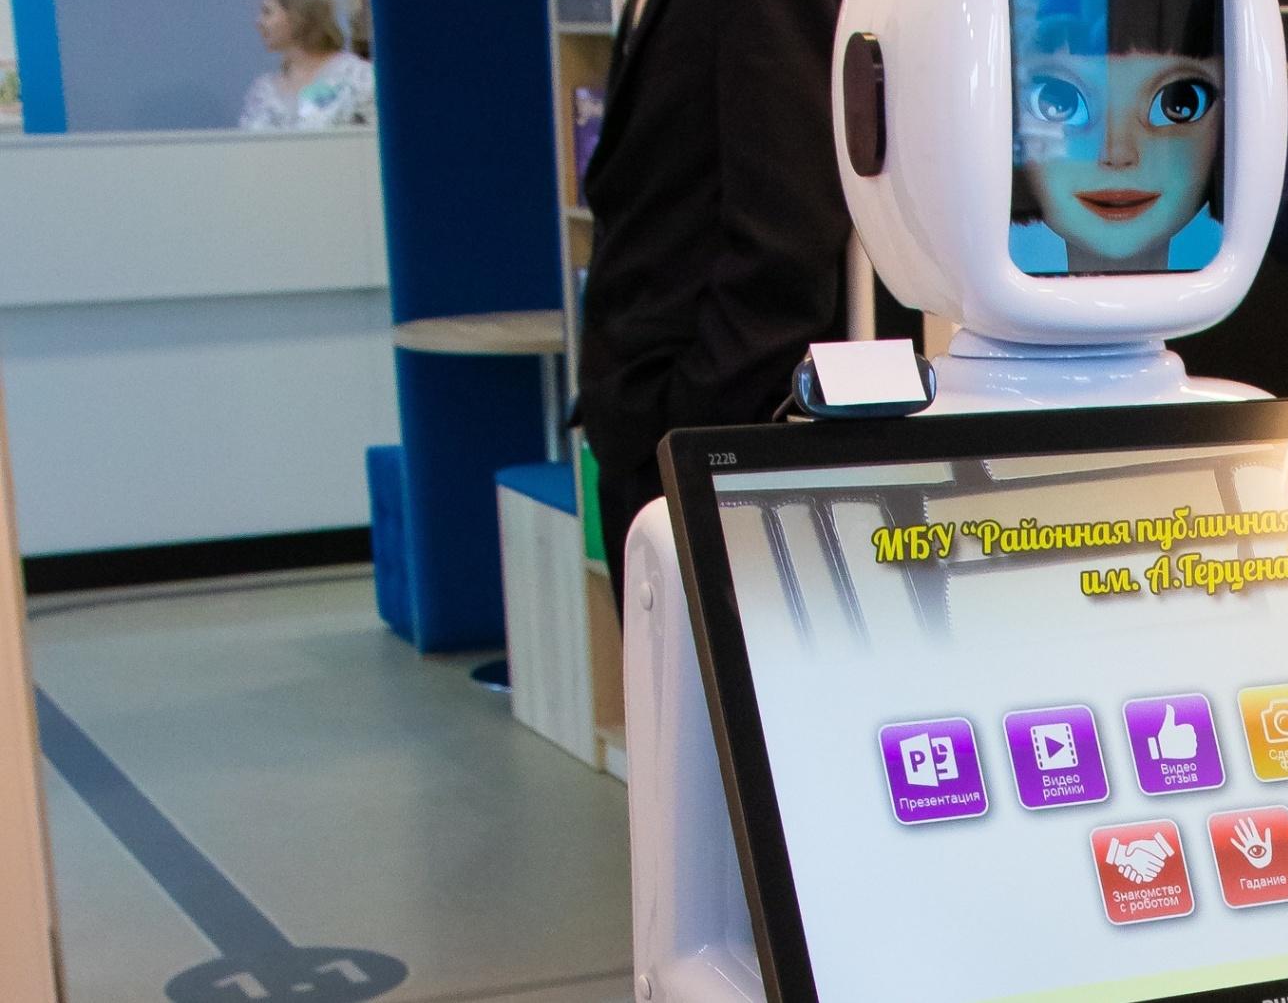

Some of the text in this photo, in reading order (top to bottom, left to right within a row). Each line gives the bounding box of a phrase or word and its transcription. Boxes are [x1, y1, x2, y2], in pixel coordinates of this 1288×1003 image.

[707, 452, 738, 466] 222B
[872, 523, 956, 563] МБУ
[1080, 567, 1141, 597] им.
[1160, 762, 1198, 777] Видео
[1042, 773, 1081, 788] Видео
[1164, 772, 1199, 785] отзыв
[1042, 784, 1085, 800] ролики
[899, 791, 981, 812] Презентация
[1239, 874, 1287, 891] Гадание
[1112, 884, 1182, 903] Знакомство
[1119, 896, 1179, 914] с роботом
